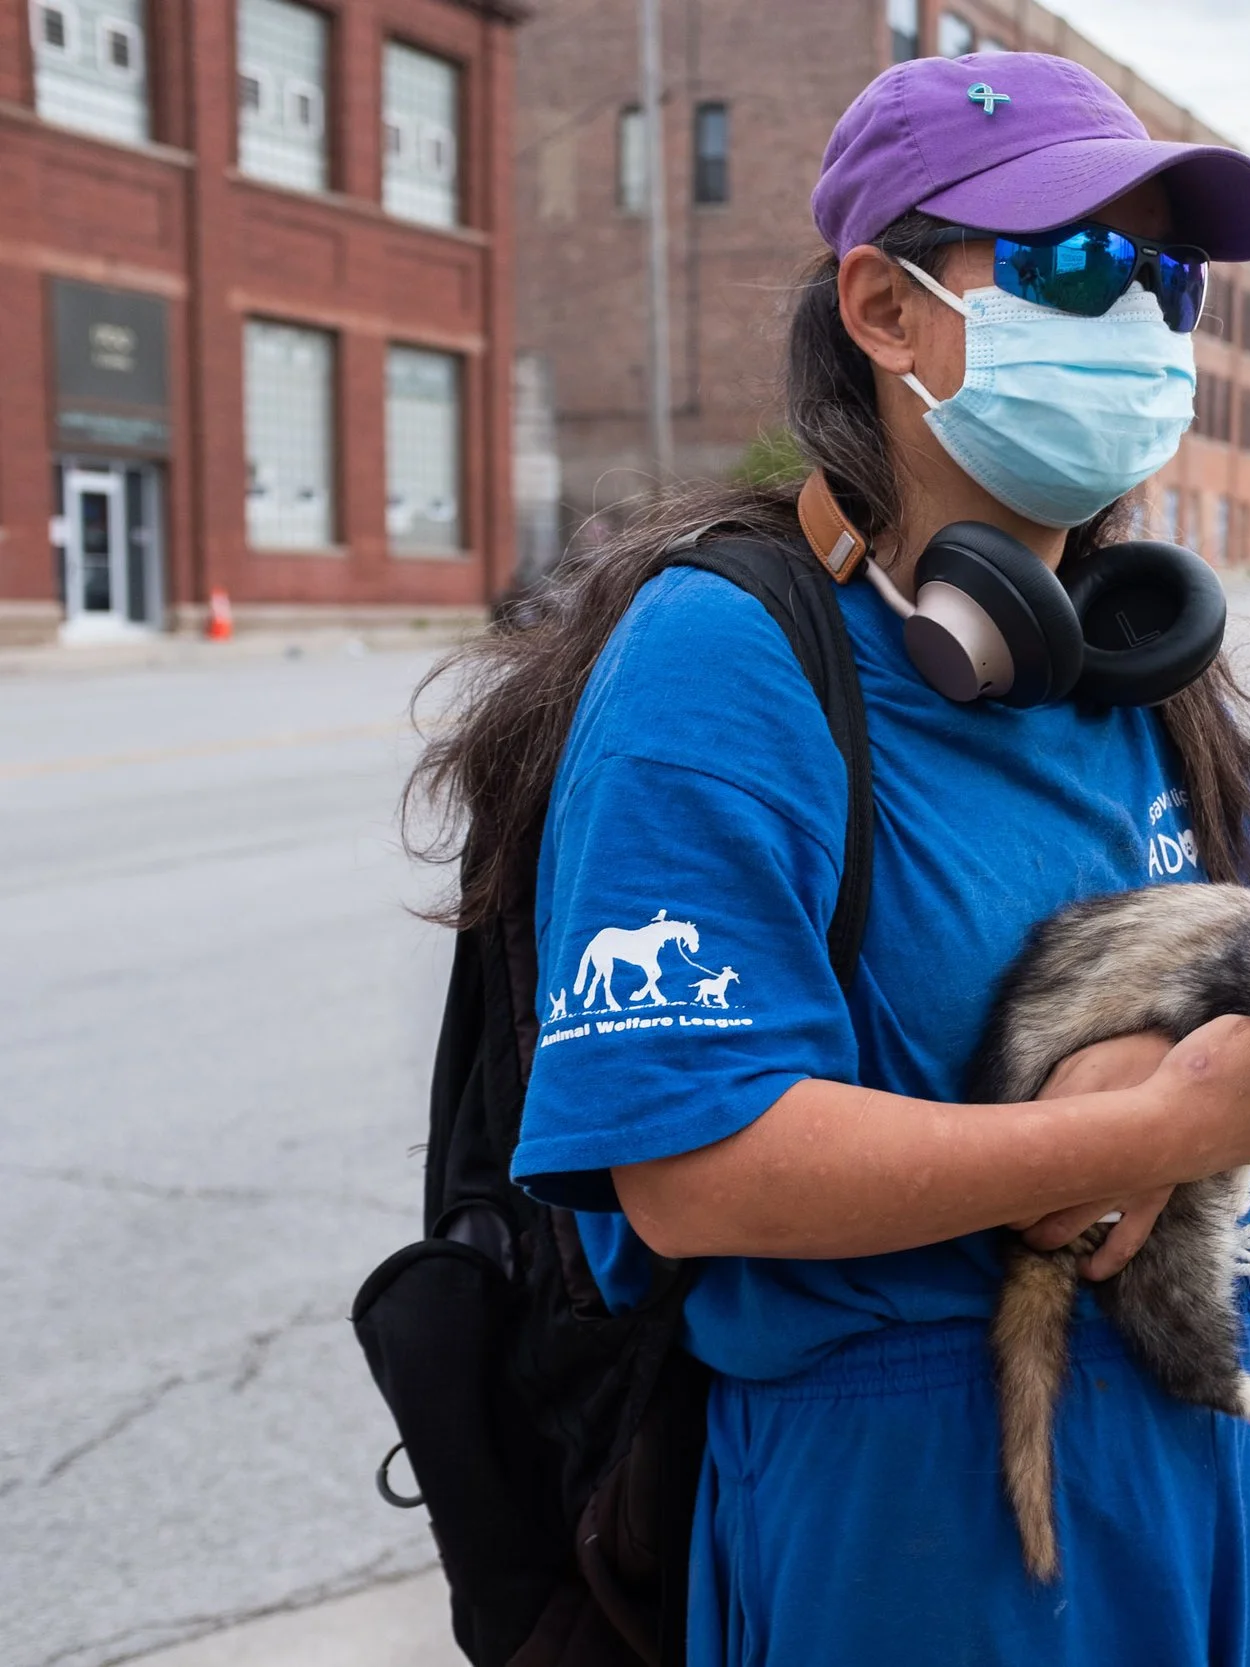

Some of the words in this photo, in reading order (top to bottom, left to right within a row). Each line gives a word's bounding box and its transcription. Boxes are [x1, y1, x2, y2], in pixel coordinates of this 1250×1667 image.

[1149, 792, 1172, 826] sav
[540, 1023, 591, 1048] Animal
[596, 1016, 674, 1035] Welfare
[679, 1015, 754, 1029] League
